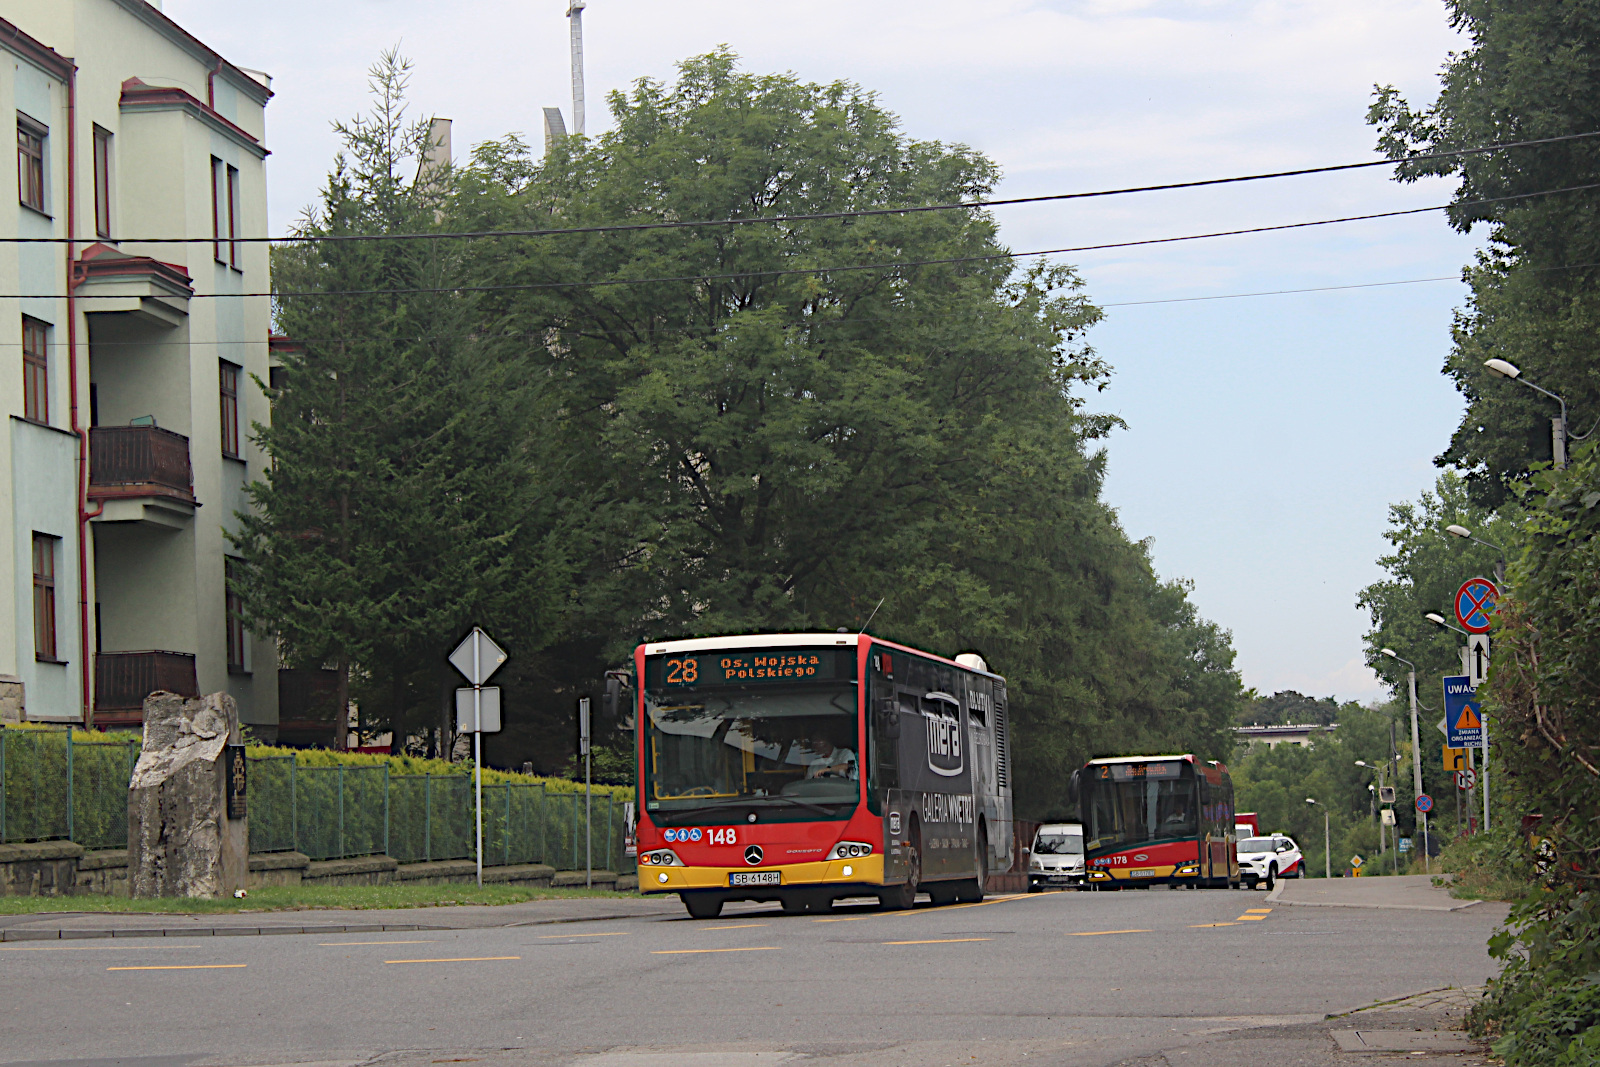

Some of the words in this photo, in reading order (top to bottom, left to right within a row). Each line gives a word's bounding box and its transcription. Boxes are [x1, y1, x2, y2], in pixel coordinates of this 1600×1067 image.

[721, 658, 749, 669] Os.
[755, 655, 819, 668] Wojska
[667, 658, 698, 683] 28
[725, 666, 815, 679] Polskiego
[1100, 765, 1109, 779] 2
[922, 792, 948, 823] GALERIA
[948, 794, 972, 833] WNĘTRZ
[706, 828, 737, 845] 148
[1112, 855, 1128, 865] 178
[735, 874, 748, 883] SB
[751, 873, 779, 883] 6148H
